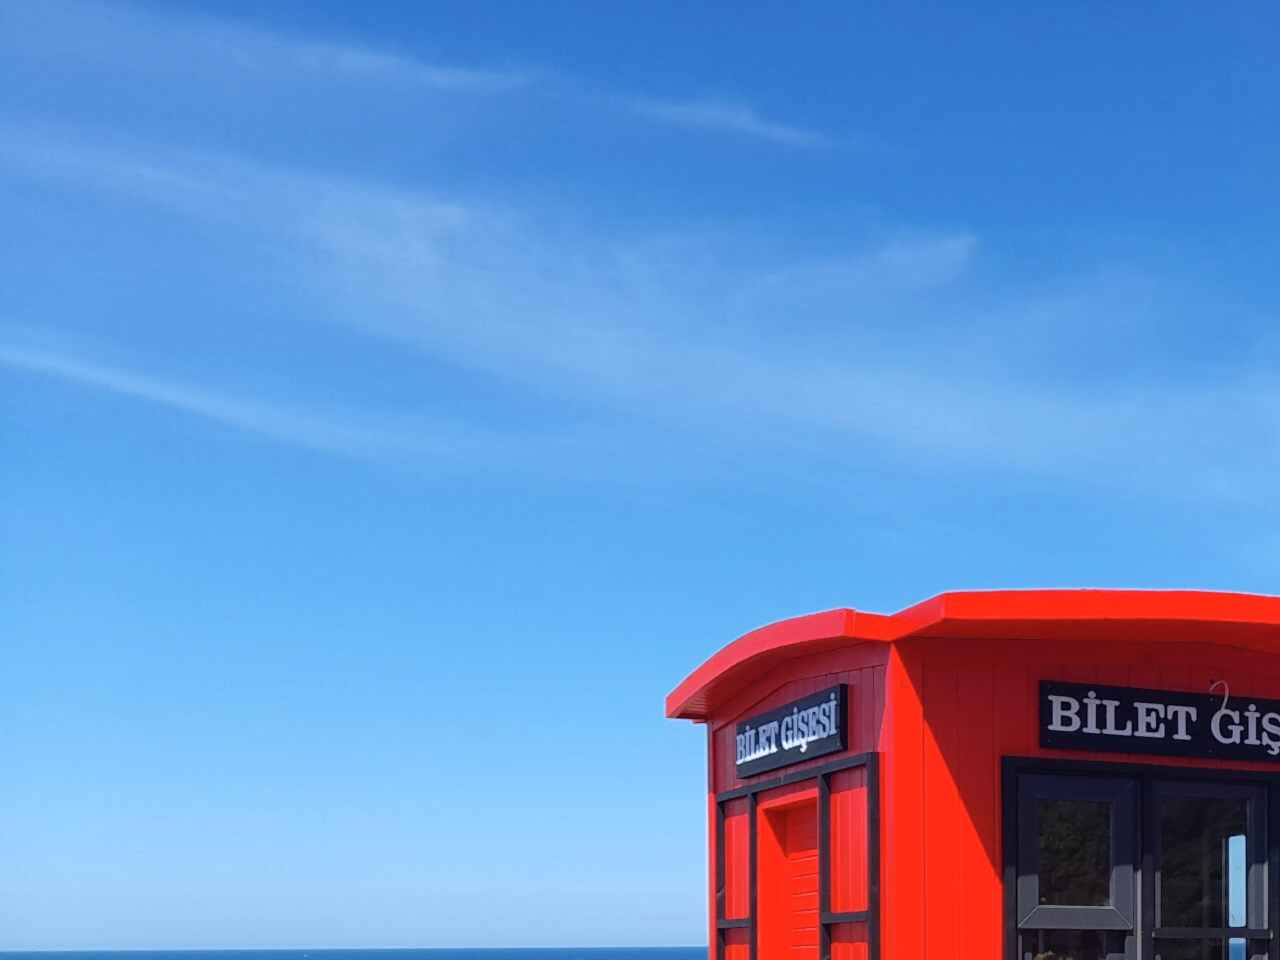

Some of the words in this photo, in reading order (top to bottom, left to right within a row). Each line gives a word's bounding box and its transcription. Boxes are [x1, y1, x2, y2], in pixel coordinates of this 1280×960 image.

[736, 725, 778, 765] BİLET
[781, 692, 837, 753] GİŞESİ
[1047, 690, 1197, 741] BİLET
